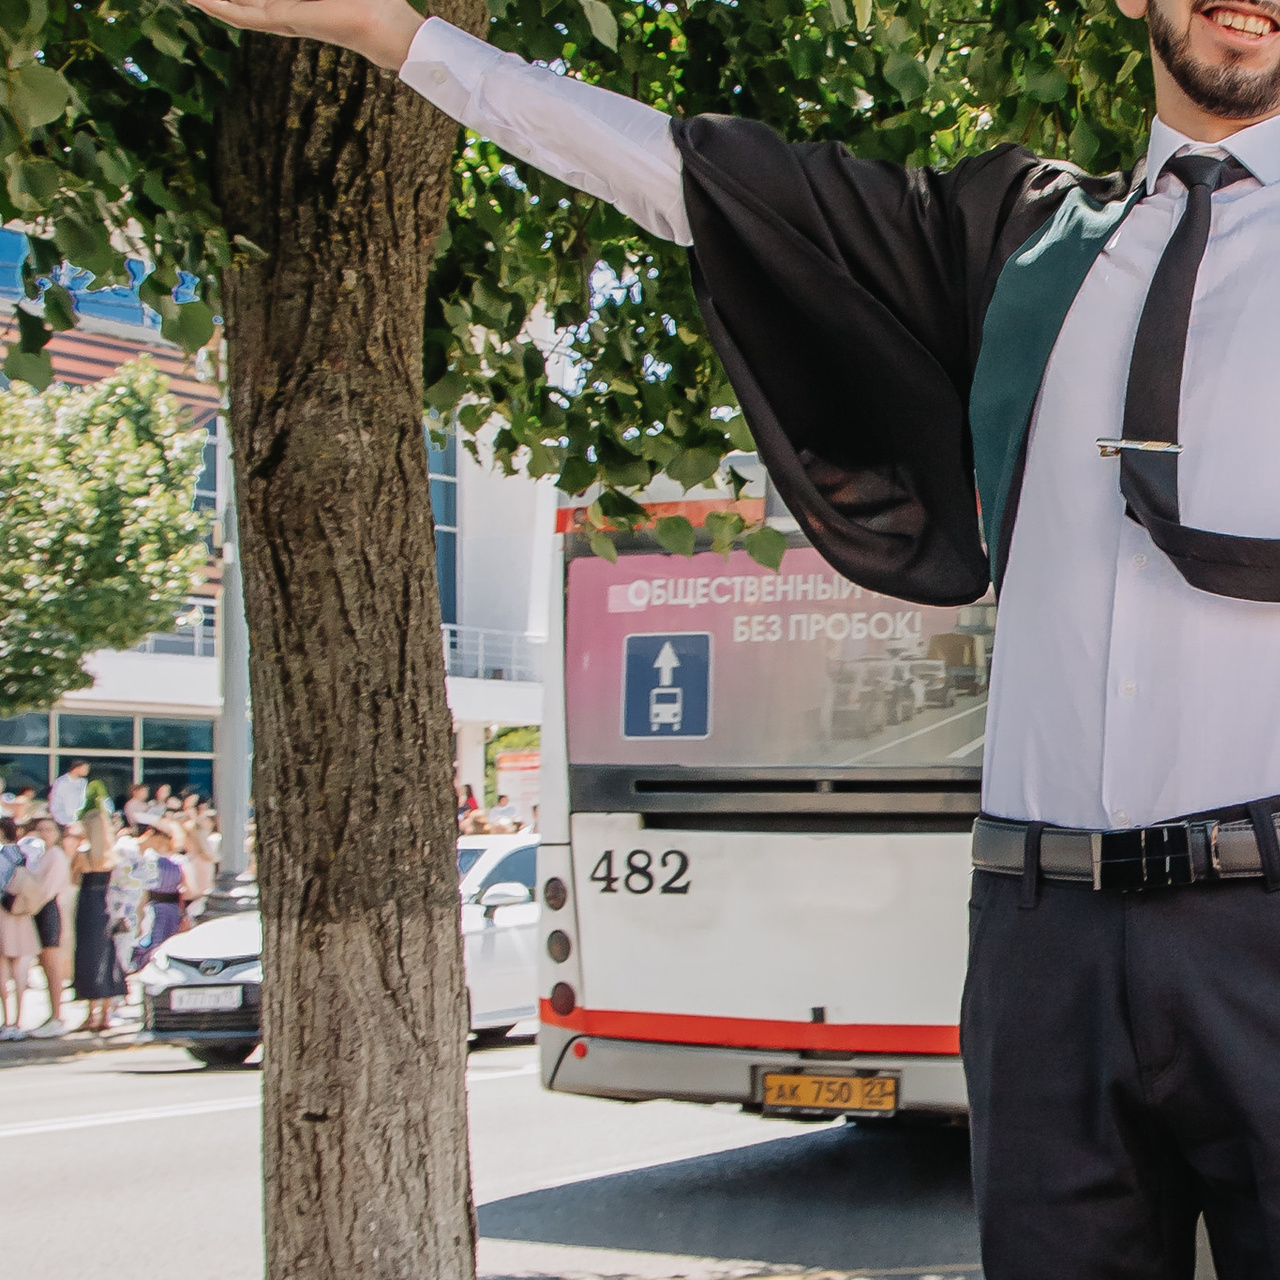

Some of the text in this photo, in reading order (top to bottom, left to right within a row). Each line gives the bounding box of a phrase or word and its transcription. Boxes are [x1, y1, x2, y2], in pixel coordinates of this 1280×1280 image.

[733, 611, 923, 642] БЕЗ ПРОБОК!
[590, 849, 692, 894] 482
[811, 1079, 853, 1104] 750
